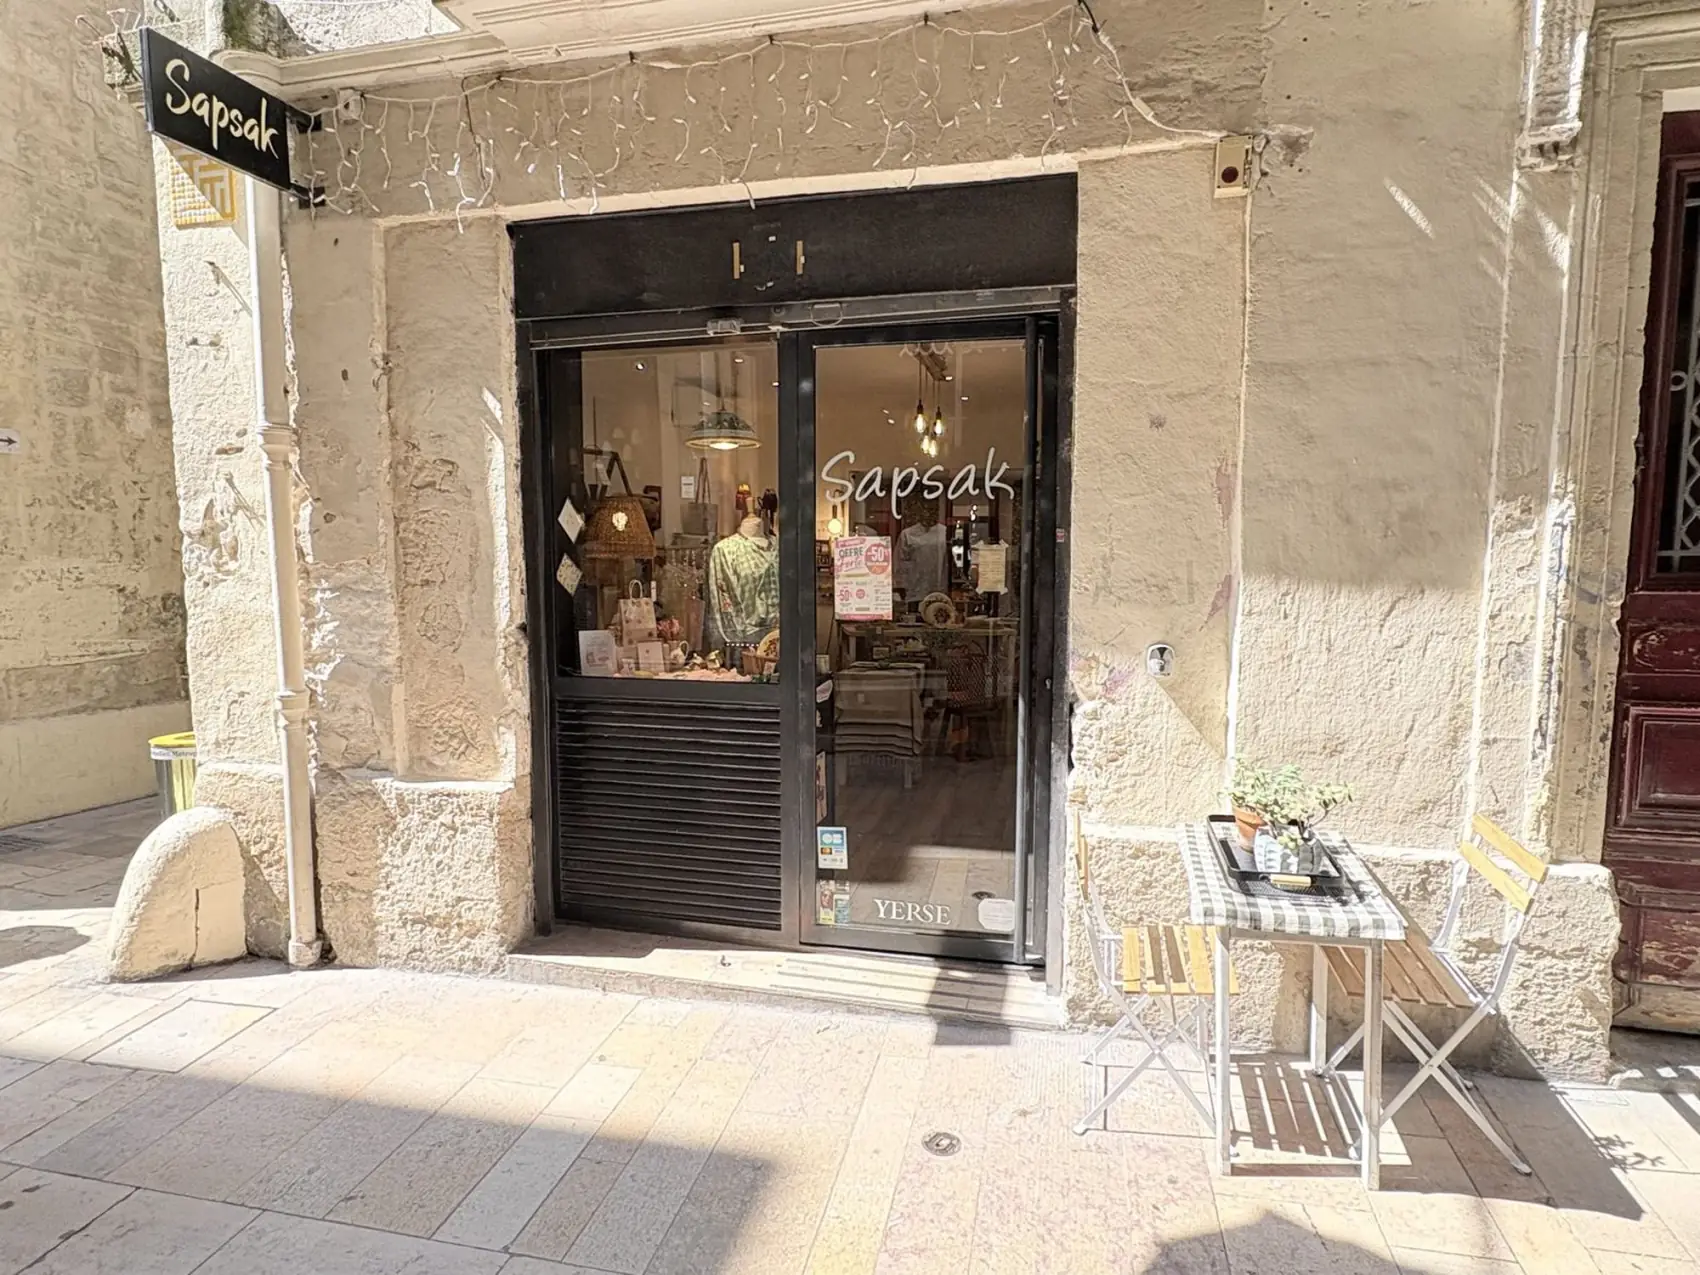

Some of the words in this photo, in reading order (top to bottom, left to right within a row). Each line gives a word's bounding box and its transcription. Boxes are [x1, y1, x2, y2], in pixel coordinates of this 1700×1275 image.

[165, 58, 280, 160] Sapsak
[821, 447, 1015, 520] Sapsak
[838, 547, 864, 557] OFFRE
[874, 899, 951, 925] YERSE
